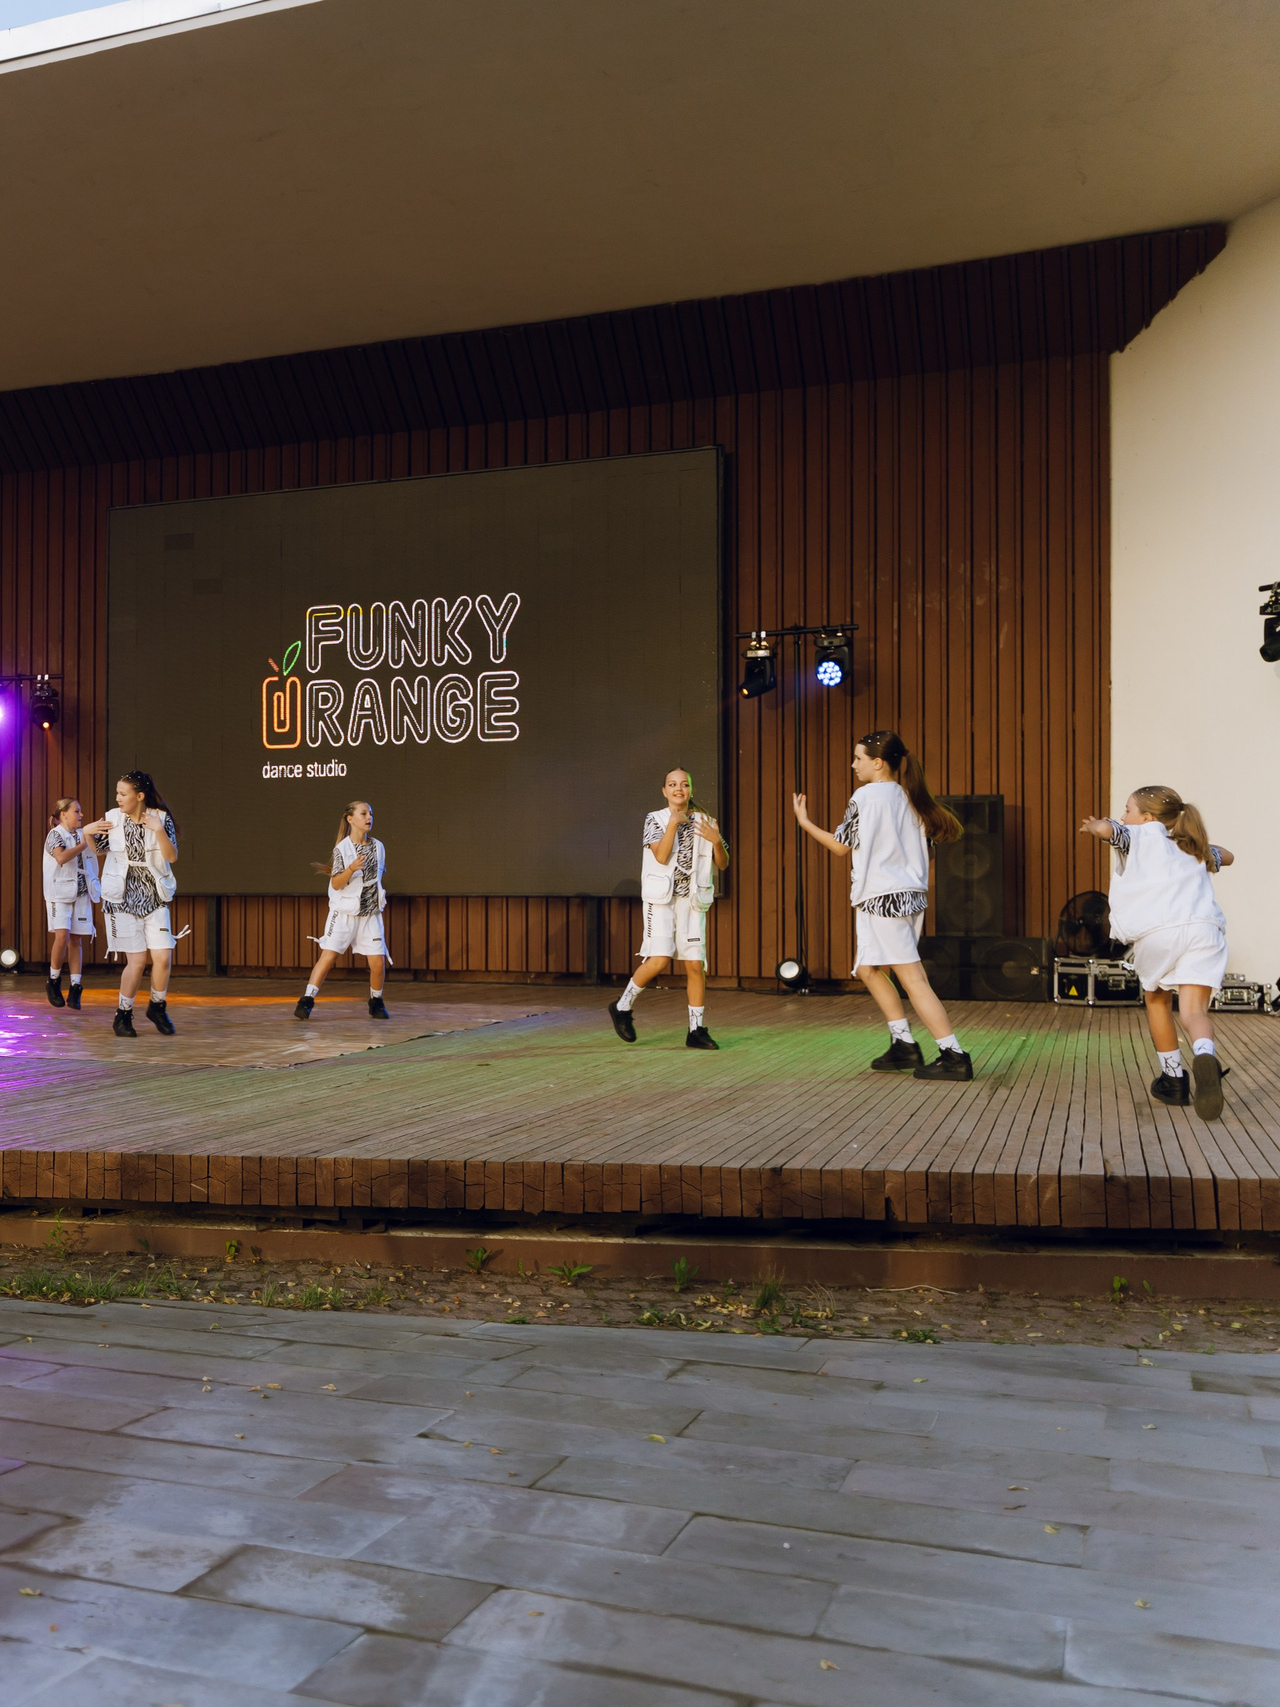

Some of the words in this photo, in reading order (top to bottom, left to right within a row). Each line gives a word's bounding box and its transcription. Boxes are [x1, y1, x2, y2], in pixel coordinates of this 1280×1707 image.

[306, 592, 520, 673] FUNKY
[262, 761, 303, 779] dance
[306, 759, 347, 778] studio
